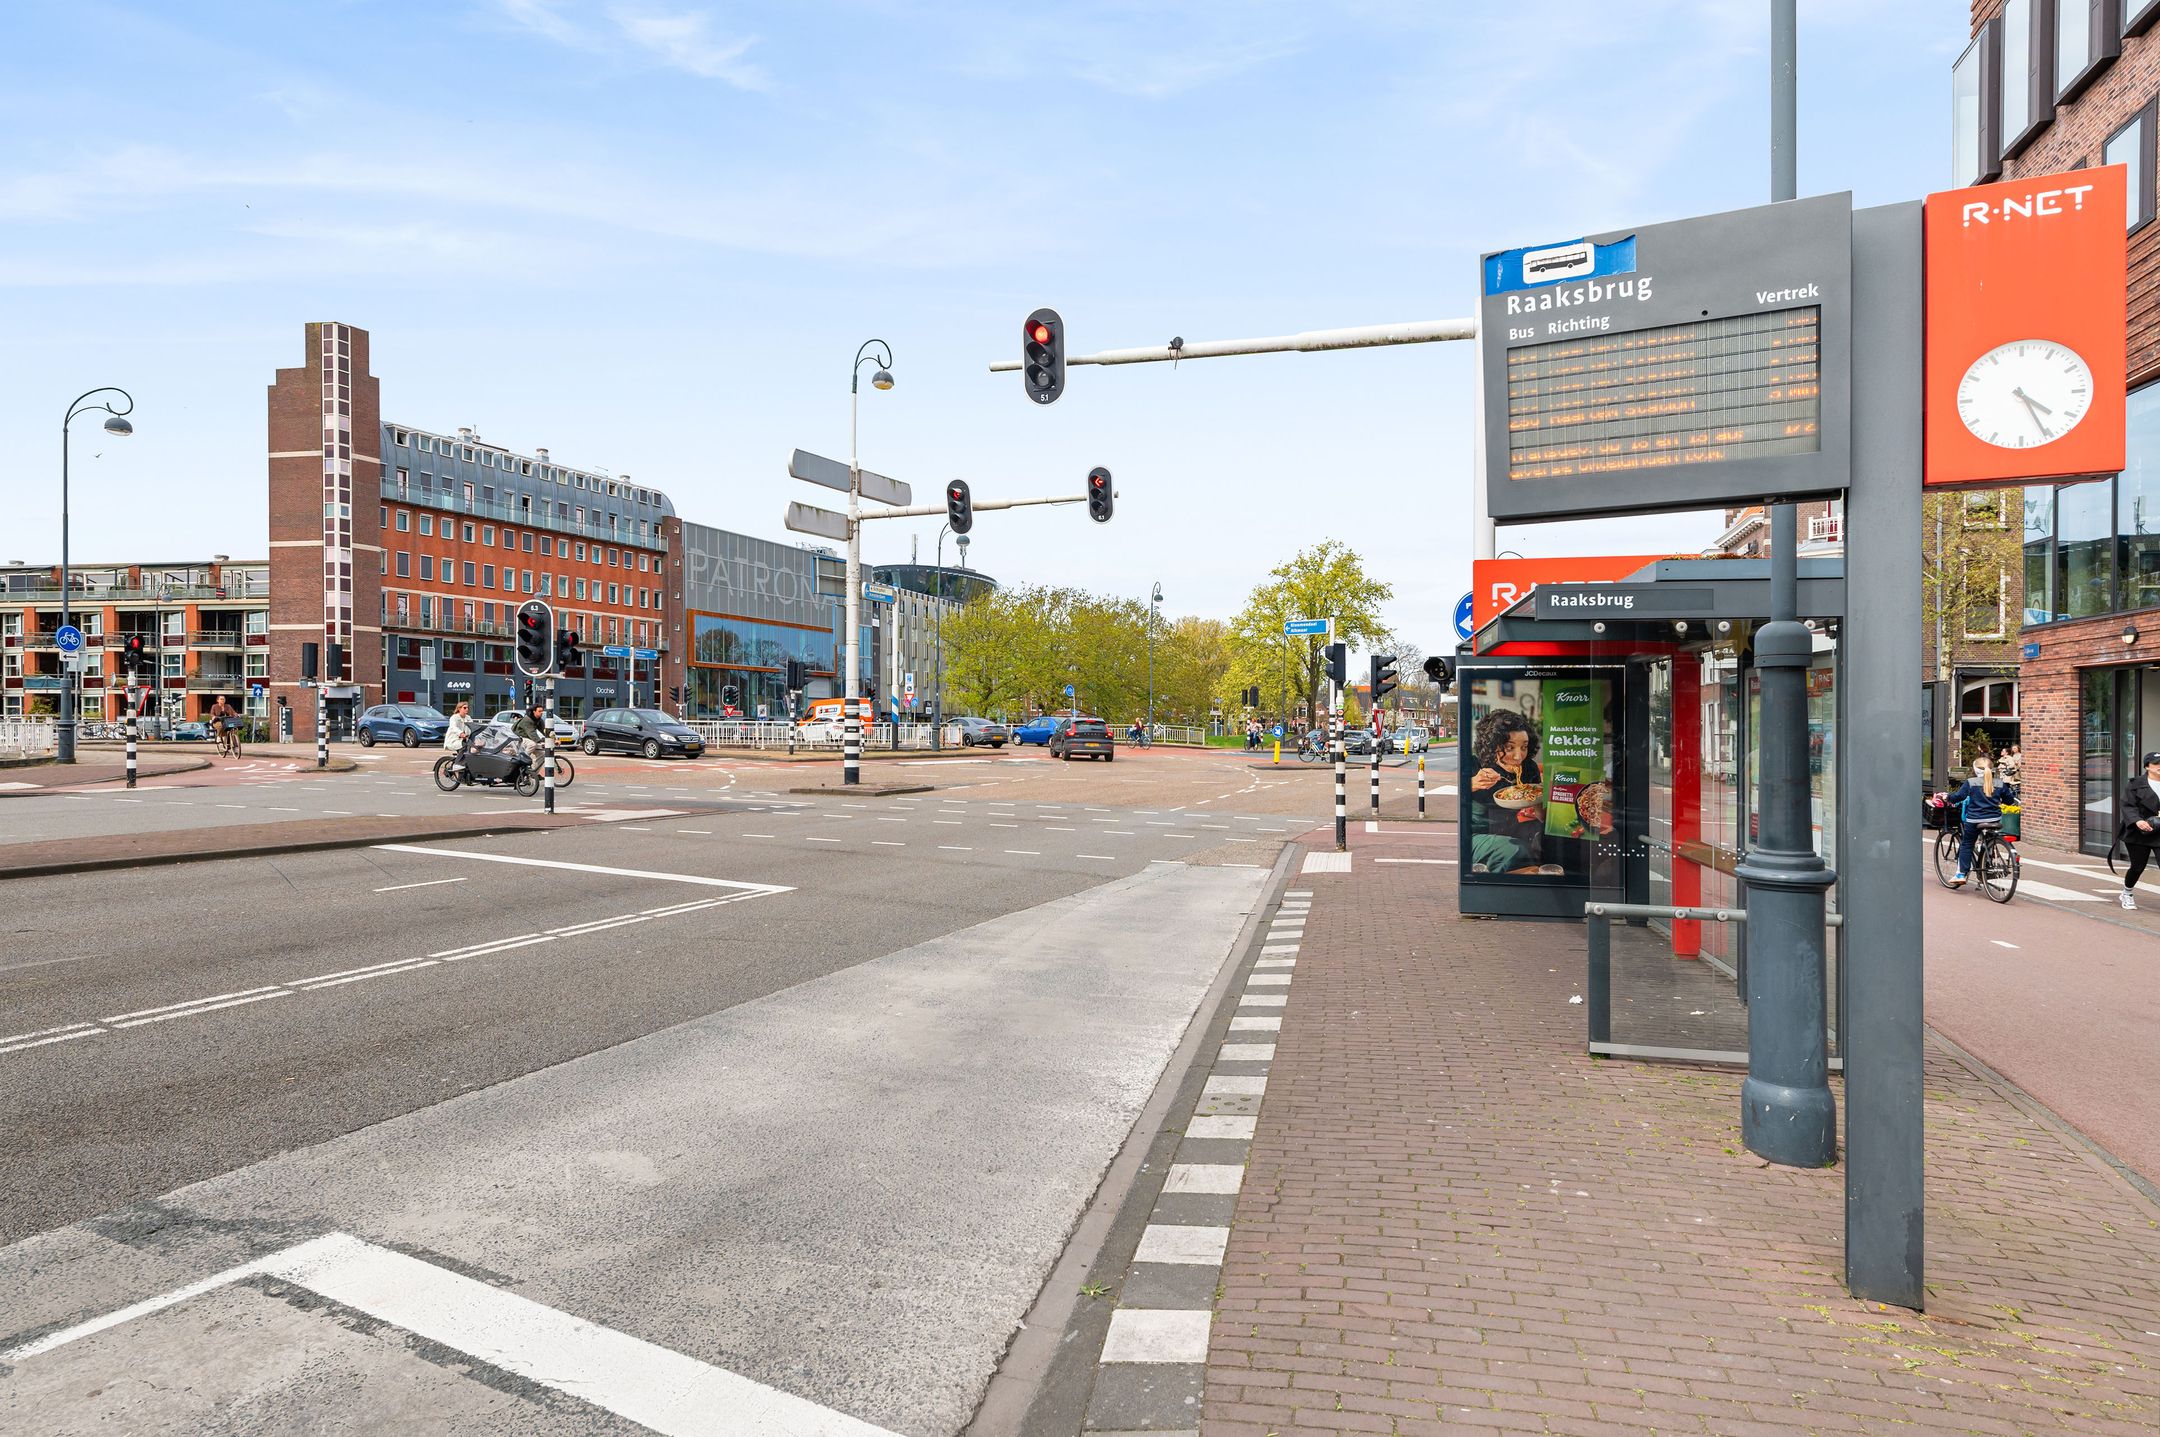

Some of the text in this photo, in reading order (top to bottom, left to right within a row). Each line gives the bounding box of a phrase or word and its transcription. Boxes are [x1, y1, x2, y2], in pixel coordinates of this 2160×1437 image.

[1507, 276, 1653, 315] Raaksbrug
[1755, 283, 1820, 306] Vertrek
[1509, 313, 1611, 341] Bus Richting
[1551, 593, 1635, 609] Raaksbrug
[1555, 692, 1590, 702] Knorr
[1548, 734, 1601, 746] lekker
[1549, 748, 1598, 758] makkelijk
[1554, 773, 1578, 783] Knorr
